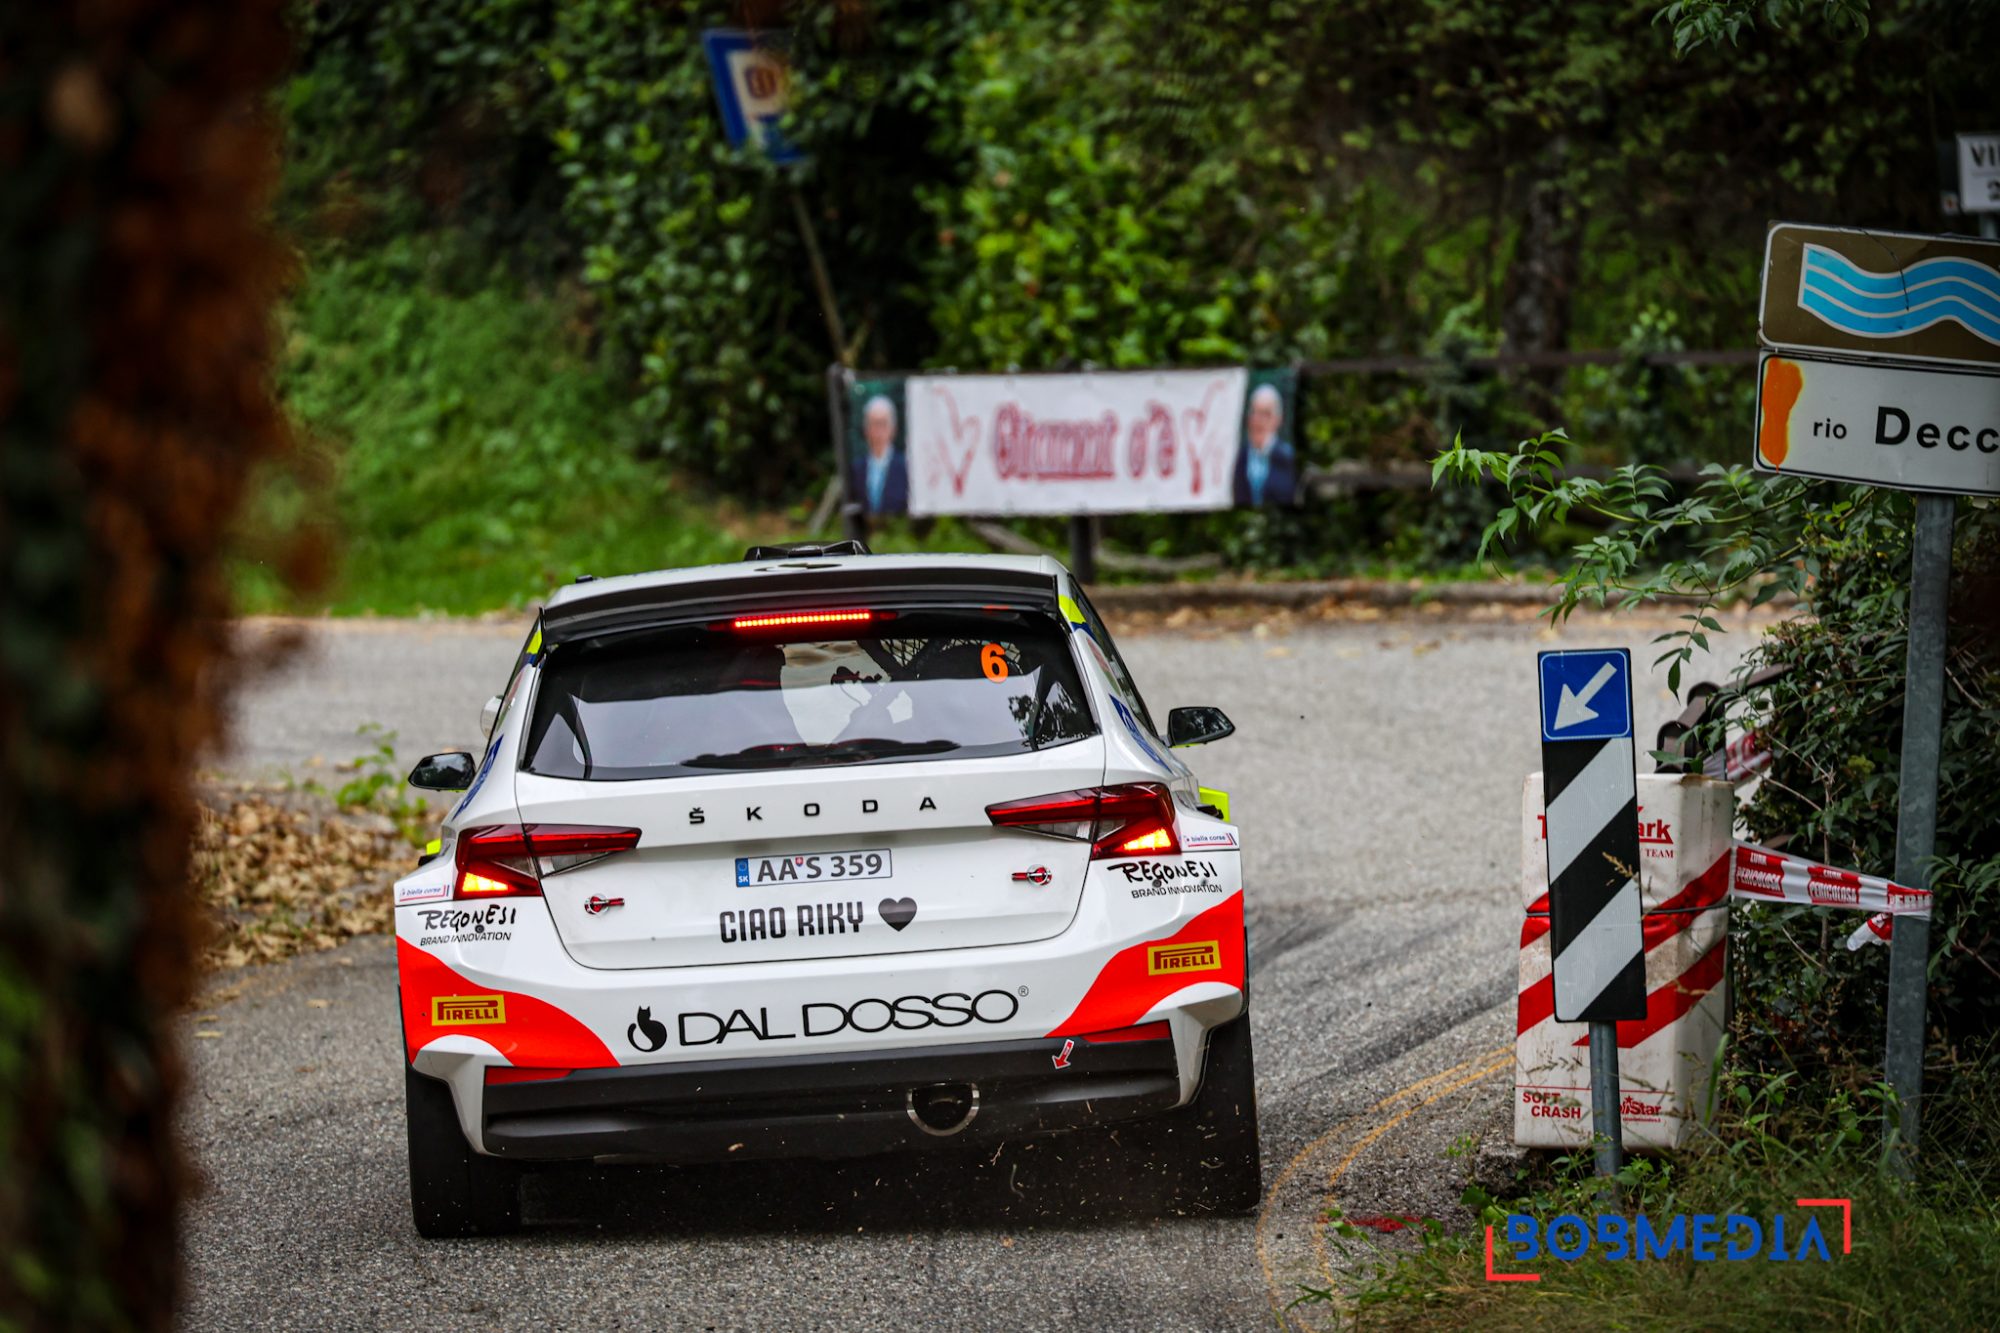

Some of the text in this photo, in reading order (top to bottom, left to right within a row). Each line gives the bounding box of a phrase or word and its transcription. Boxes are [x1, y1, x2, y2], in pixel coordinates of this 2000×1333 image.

[1813, 406, 1999, 454] rio Decc
[981, 642, 1009, 684] 6
[688, 797, 937, 824] ŠKODA
[830, 853, 883, 878] 359
[1645, 849, 1674, 859] TEAM
[738, 875, 749, 883] SK
[1107, 860, 1218, 883] REGONESI
[1131, 884, 1223, 899] BRAND INNOVATION
[417, 904, 516, 932] REGONESI
[719, 901, 864, 943] CIAO RIKY
[420, 932, 512, 947] BRAND INNOVATION
[1154, 945, 1215, 970] PIRELLI
[437, 1000, 498, 1020] PIRELLI
[678, 1007, 796, 1046] DAL
[1523, 1091, 1560, 1104] SOFT
[1531, 1106, 1581, 1119] CRASH
